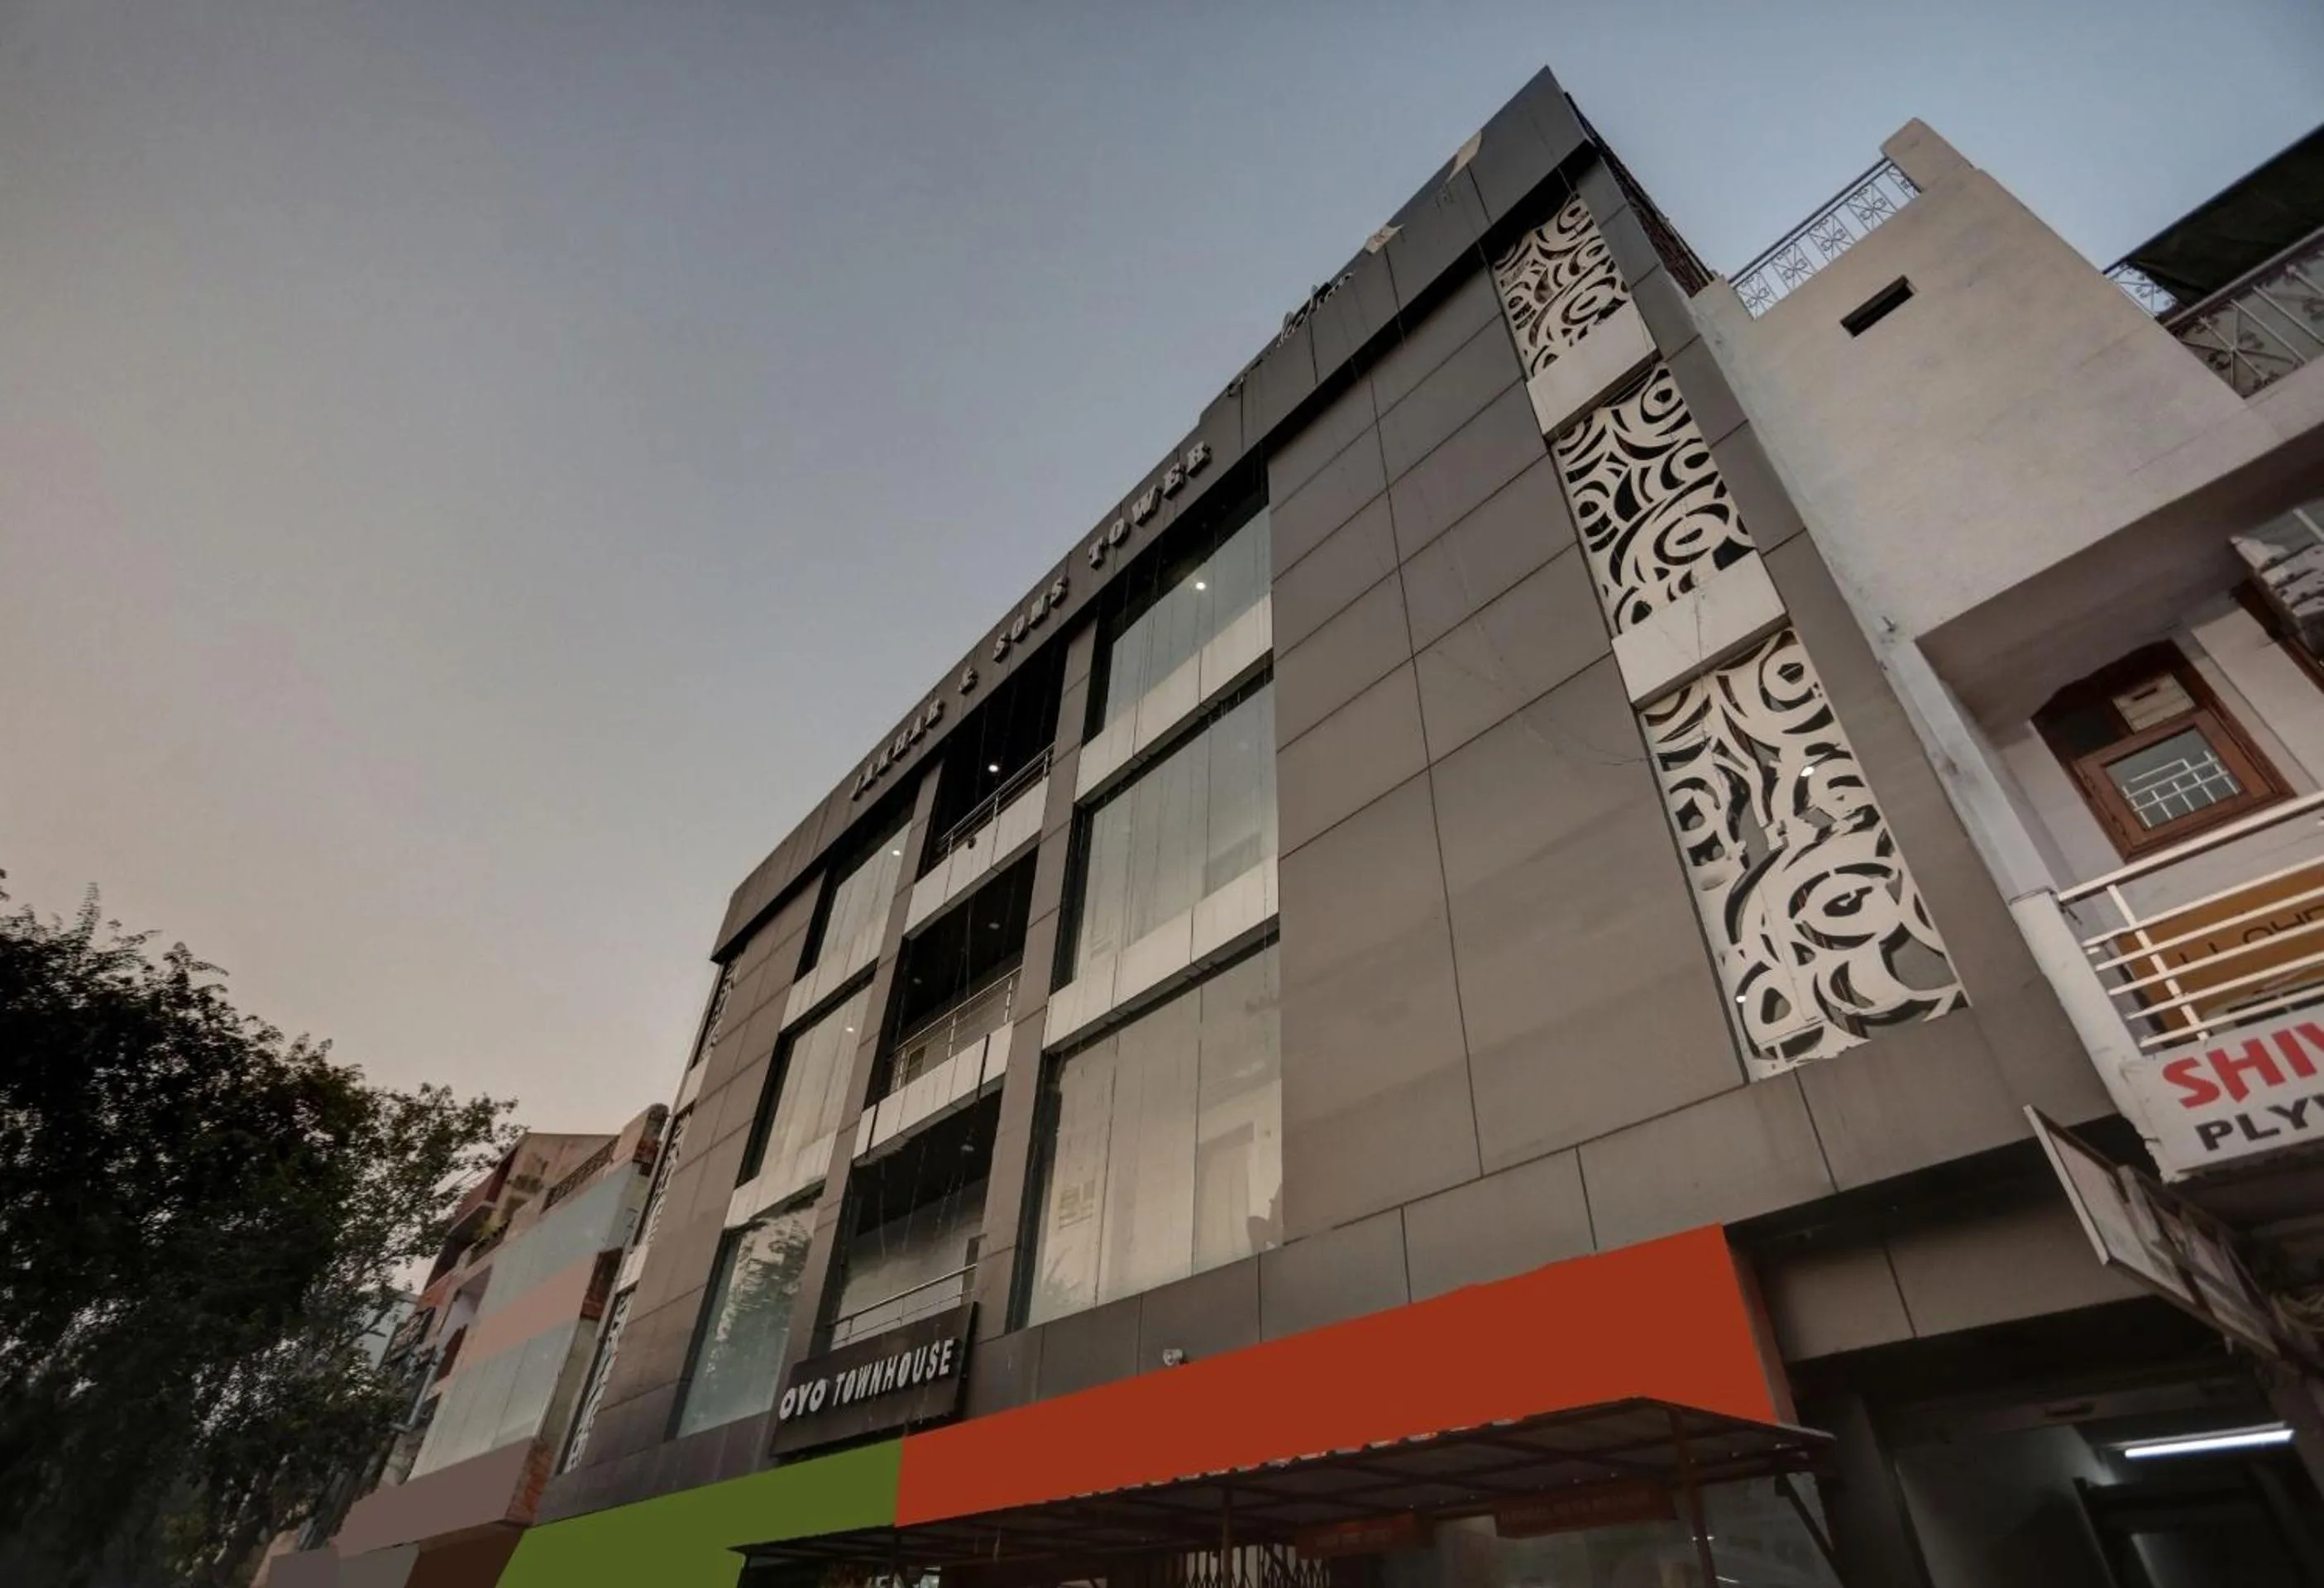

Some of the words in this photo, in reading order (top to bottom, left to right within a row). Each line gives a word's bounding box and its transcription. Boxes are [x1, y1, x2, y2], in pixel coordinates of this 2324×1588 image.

[993, 576, 1069, 662] SONS
[1088, 440, 1211, 569] TOWER
[2194, 1093, 2324, 1151] PLY
[779, 1379, 827, 1420] OYO
[833, 1338, 954, 1406] TOWNHOUSE
